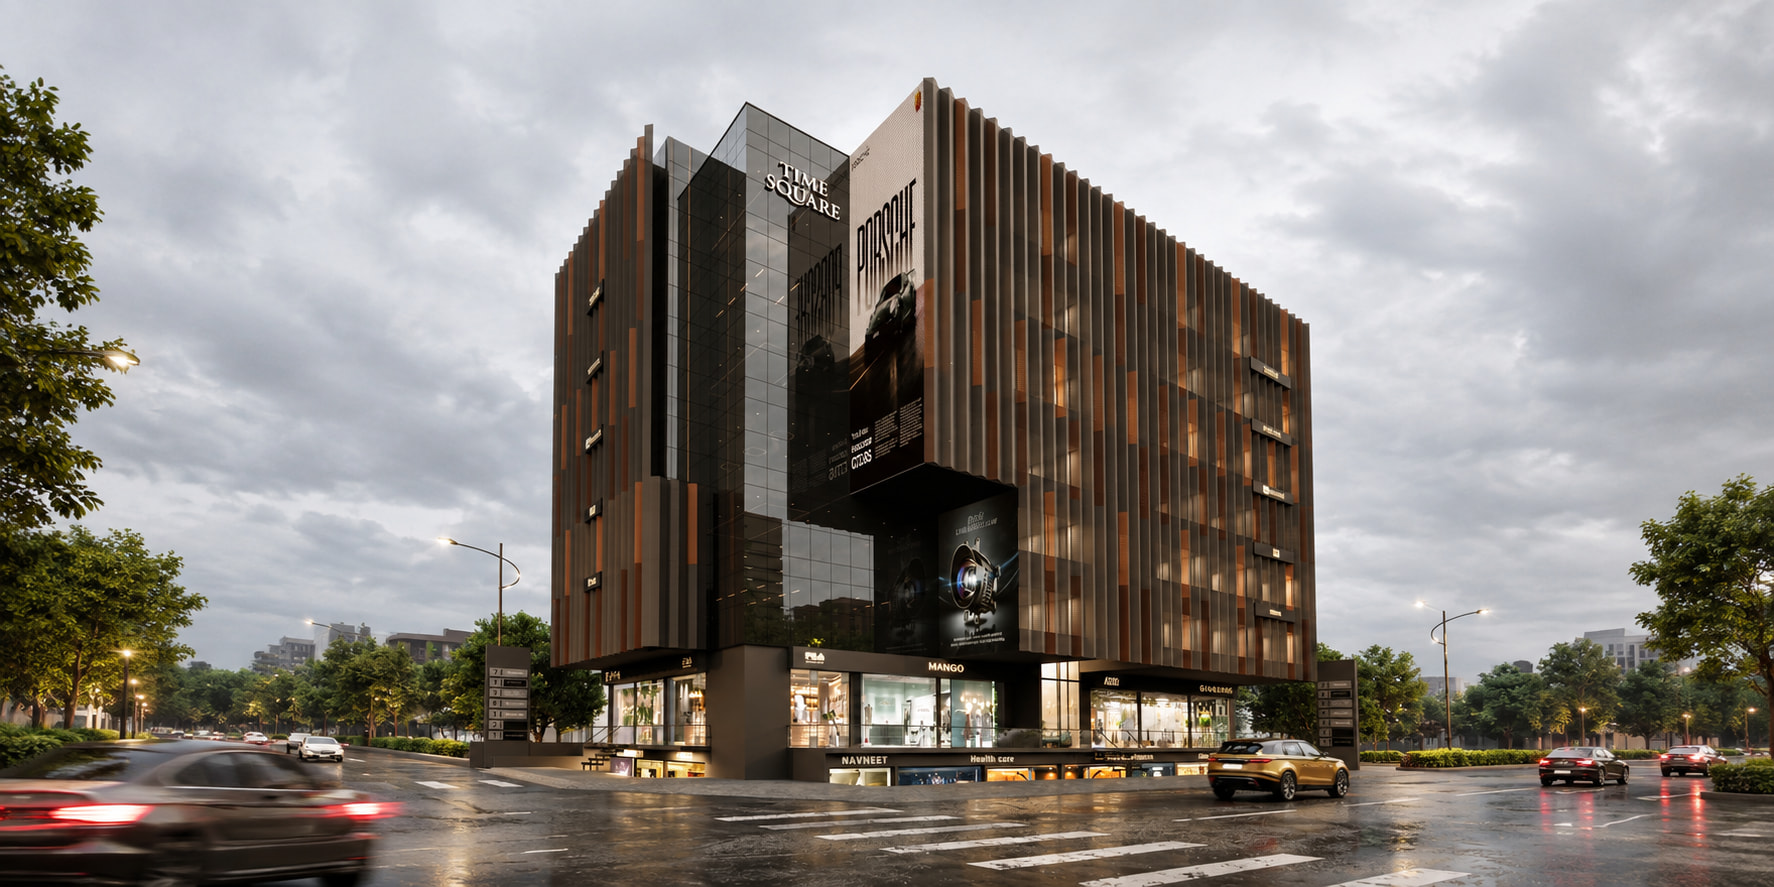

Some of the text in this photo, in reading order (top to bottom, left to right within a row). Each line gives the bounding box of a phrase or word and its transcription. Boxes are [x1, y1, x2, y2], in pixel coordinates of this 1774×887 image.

[779, 161, 828, 197] TIME
[765, 174, 840, 220] SQUARE
[857, 177, 917, 273] PORSCHE
[928, 661, 965, 673] MANGO
[841, 755, 888, 765] NAVNEET
[970, 755, 1015, 764] Health care
